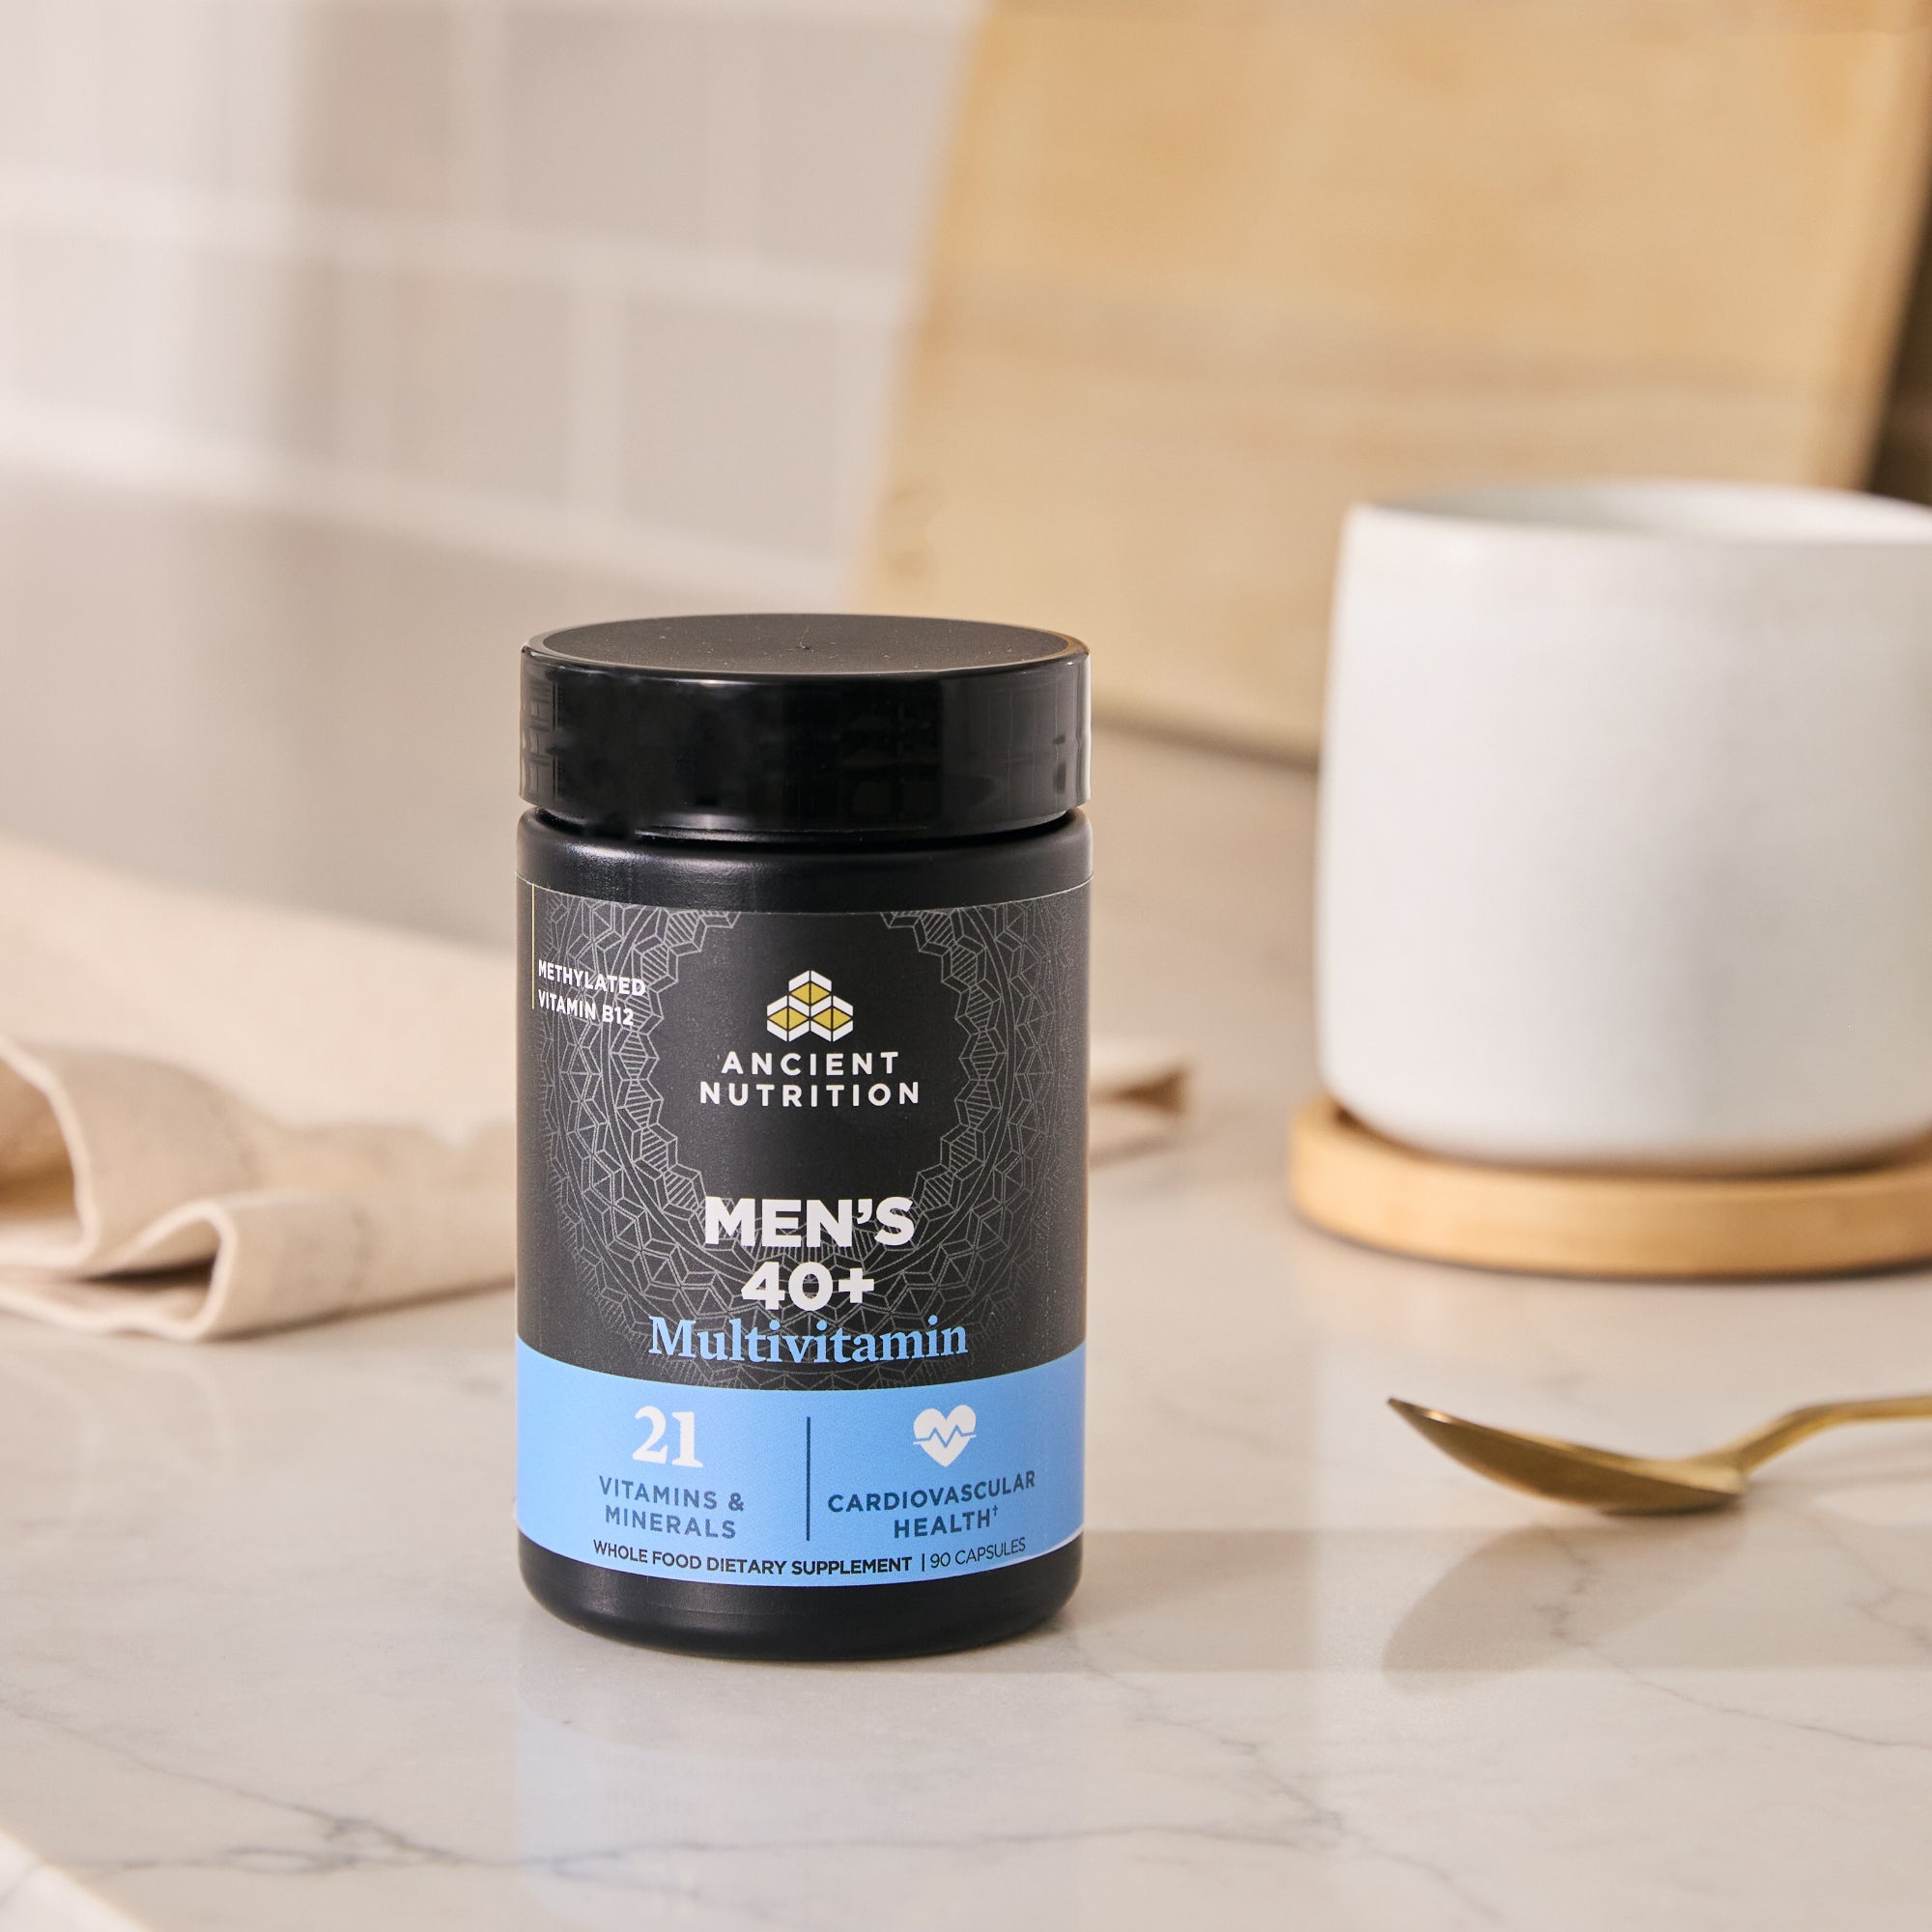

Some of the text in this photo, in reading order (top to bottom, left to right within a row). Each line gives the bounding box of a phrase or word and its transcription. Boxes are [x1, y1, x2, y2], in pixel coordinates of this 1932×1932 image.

[538, 959, 646, 997] METHYLATED
[538, 990, 635, 1026] VITAMIN B12
[721, 1051, 899, 1076] ANCIENT
[699, 1081, 919, 1107] NUTRITION
[703, 1196, 915, 1247] MEN’S
[741, 1262, 875, 1311] 40+
[648, 1316, 969, 1363] Multivitamin
[632, 1406, 703, 1468] 21
[599, 1475, 745, 1511] VITAMINS &
[827, 1470, 1036, 1513] CARDIOVASCULAR
[605, 1505, 736, 1539] MINERALS
[593, 1537, 1026, 1575] WHOLE FOOD DIETARY SUPPLEMENT 90 CAPSULES
